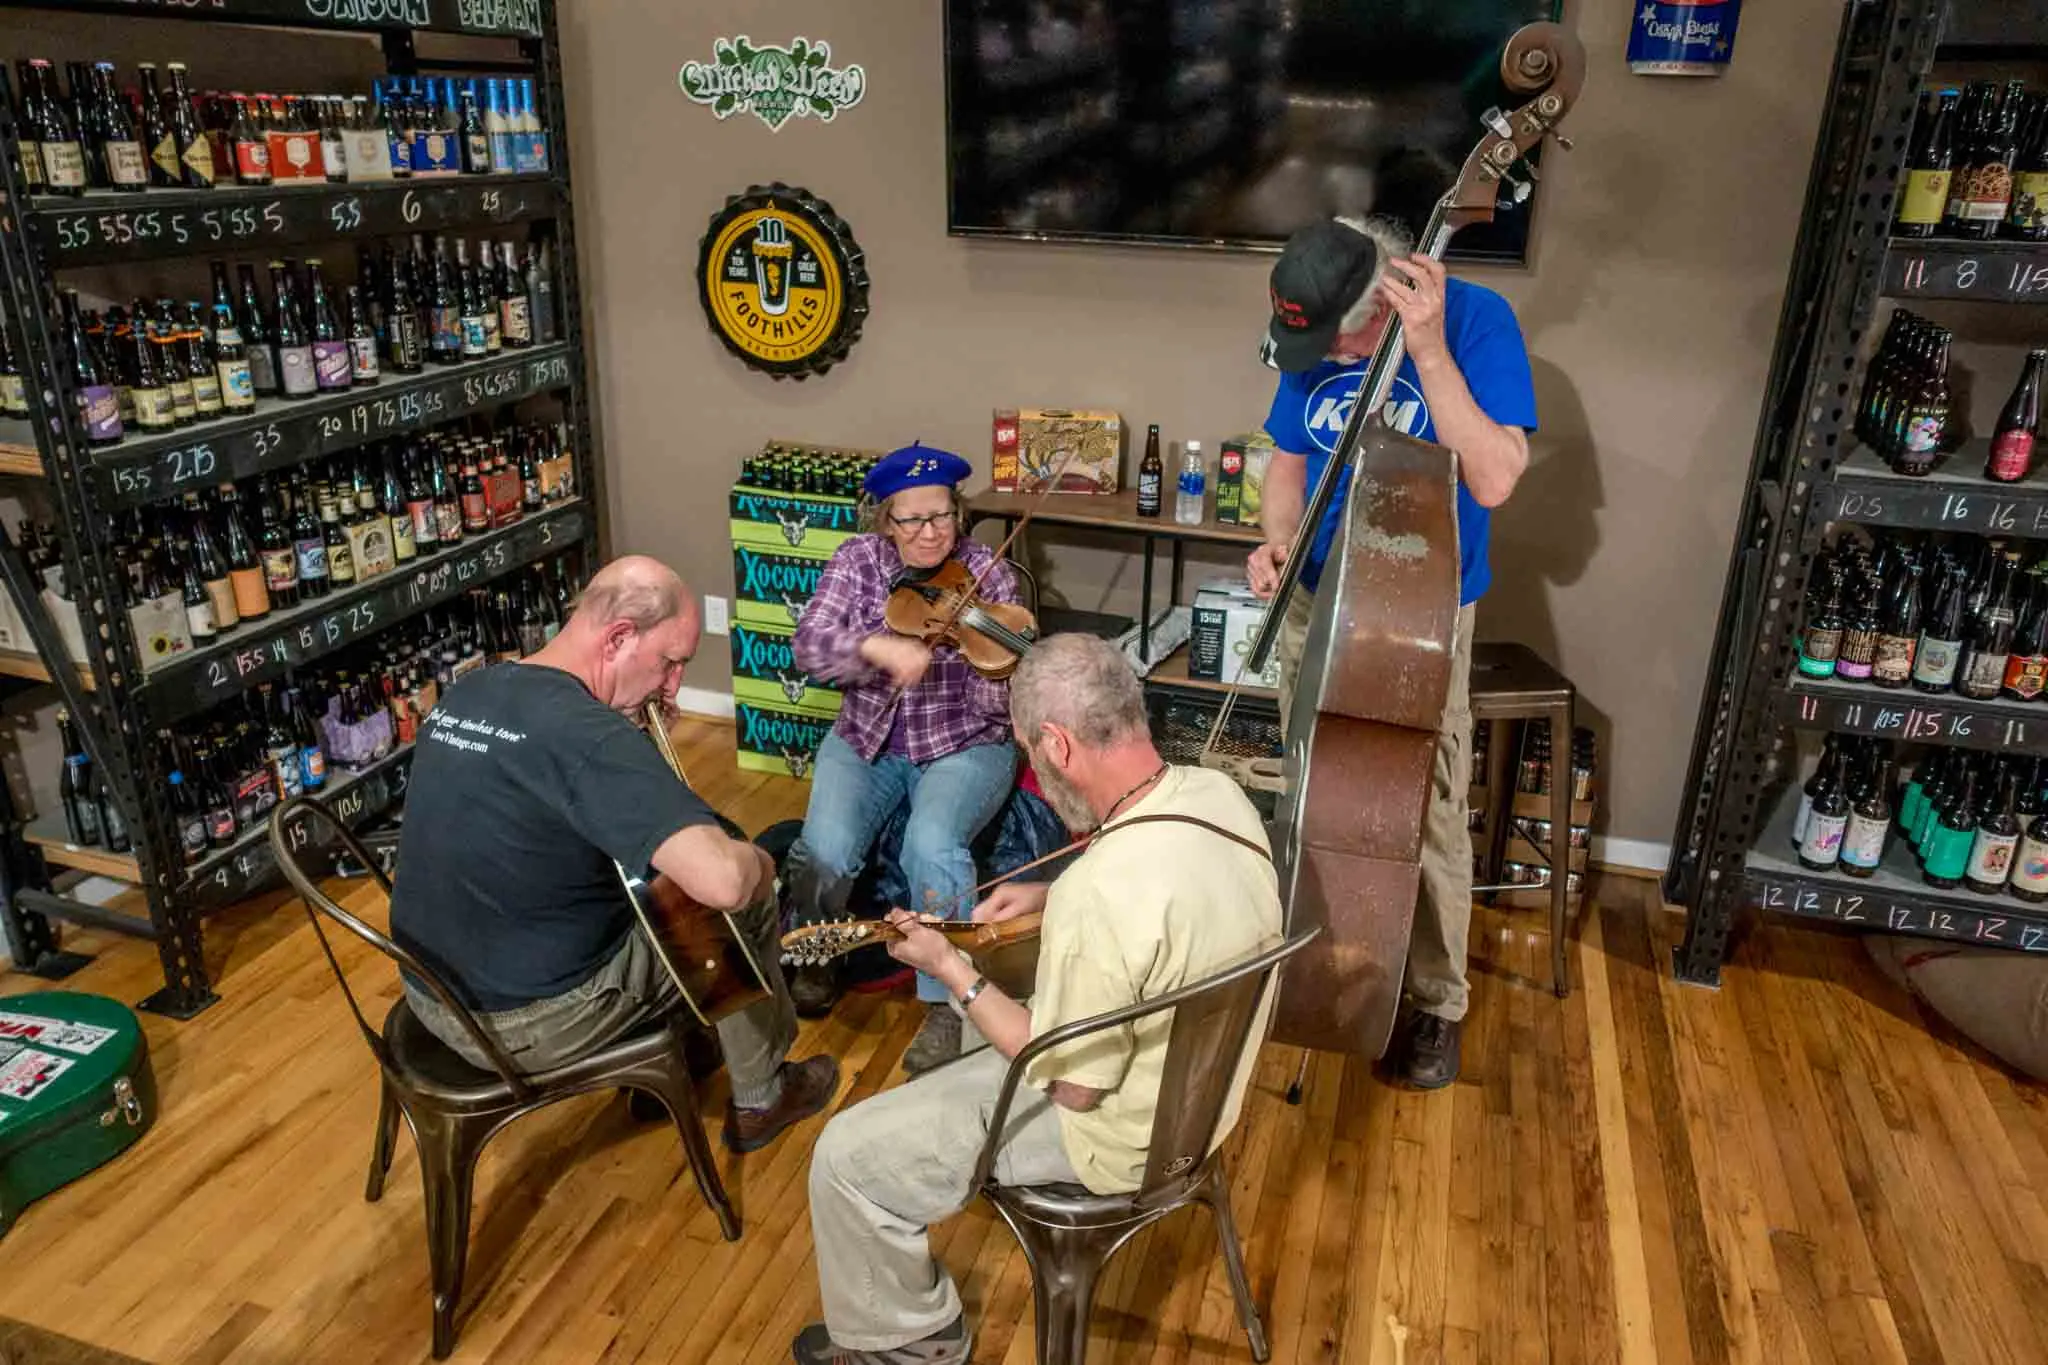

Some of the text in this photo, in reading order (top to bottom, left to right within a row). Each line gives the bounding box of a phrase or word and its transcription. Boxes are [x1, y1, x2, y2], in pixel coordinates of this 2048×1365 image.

[171, 214, 189, 244] 5
[203, 210, 222, 241] 5
[263, 201, 284, 232] 5
[401, 190, 421, 223] 6
[759, 219, 785, 243] 10
[1957, 259, 1977, 289] 8
[730, 290, 818, 339] FOOTHILLS
[112, 466, 152, 495] 15.5
[167, 443, 217, 484] 2.75
[319, 415, 343, 438] 20
[351, 404, 370, 436] 19
[1943, 493, 1968, 521] 16
[208, 661, 229, 689] 2
[539, 521, 552, 545] 3
[1802, 694, 1818, 721] 11
[1844, 705, 1862, 728] 11
[1904, 708, 1943, 739] 11.5
[1949, 714, 1974, 737] 16
[2003, 719, 2024, 745] 11
[238, 857, 250, 878] 4
[288, 822, 308, 853] 15
[1761, 884, 1785, 911] 12
[1794, 890, 1821, 912] 12
[1835, 896, 1865, 921] 12
[1888, 905, 1915, 930] 12
[1929, 911, 1955, 931] 12
[1975, 918, 2007, 941] 12
